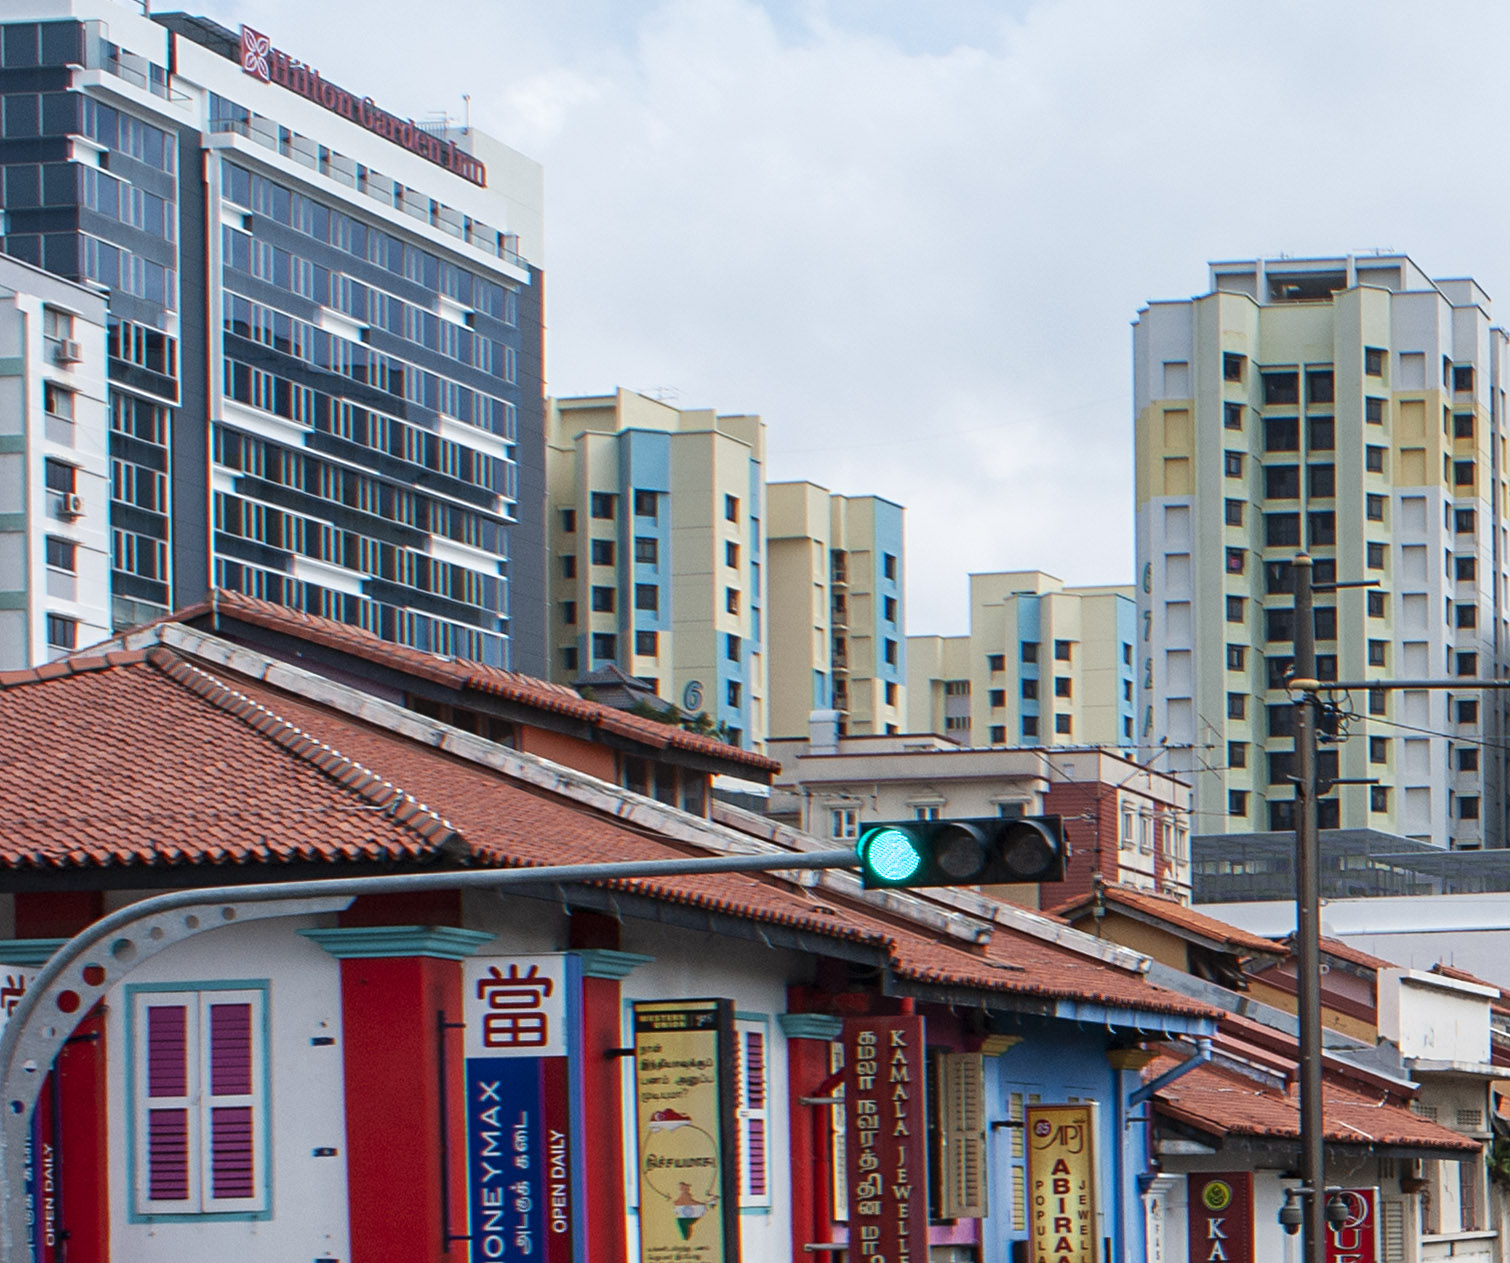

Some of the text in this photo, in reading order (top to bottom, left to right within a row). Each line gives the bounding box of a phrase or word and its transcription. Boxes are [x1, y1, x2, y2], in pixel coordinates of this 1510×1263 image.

[271, 48, 487, 189] Hilton Garden Inn
[888, 1030, 910, 1136] KAMALA
[45, 1143, 56, 1247] OPEN DAILY
[550, 1129, 566, 1234] OPEN DAILY
